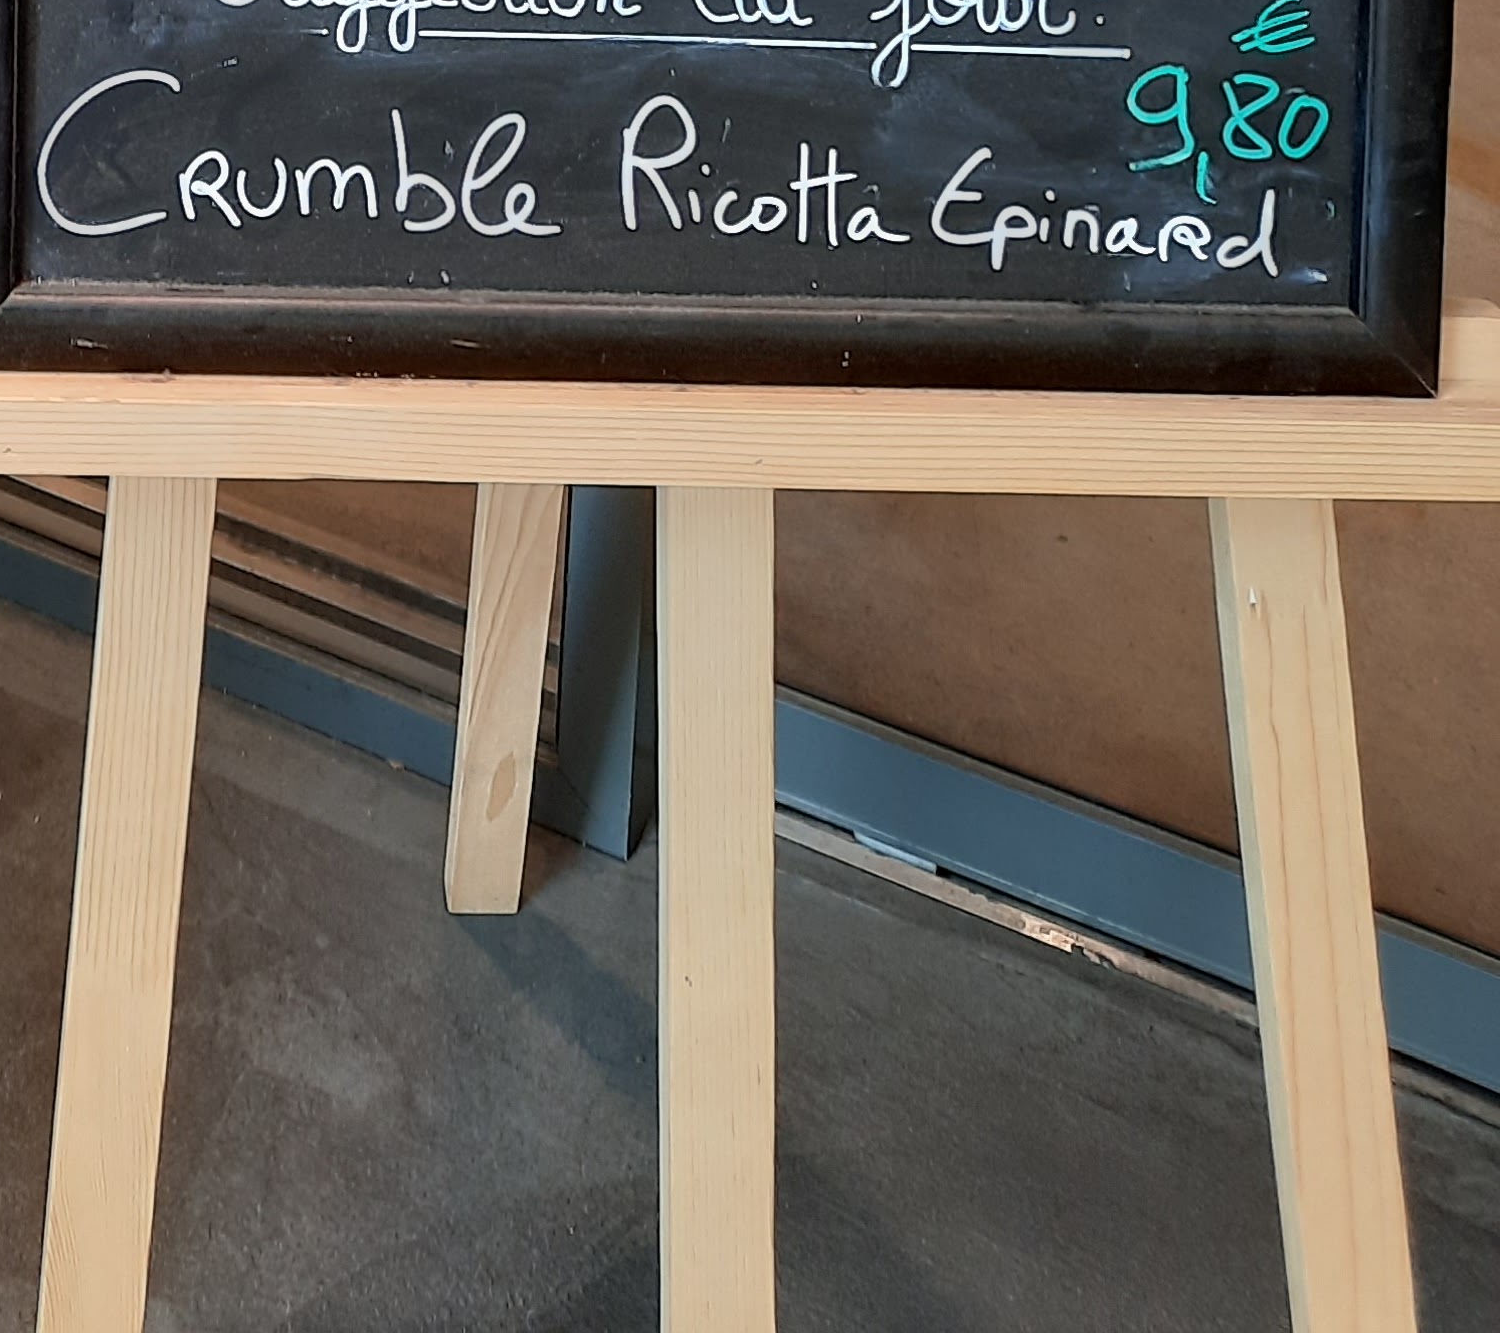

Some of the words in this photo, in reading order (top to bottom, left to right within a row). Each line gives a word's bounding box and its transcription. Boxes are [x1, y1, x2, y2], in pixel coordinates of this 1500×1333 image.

[36, 70, 561, 235] Crumble
[621, 95, 910, 247] Ricotta
[931, 147, 1279, 278] Epinard
[1127, 66, 1328, 204] 9,80
